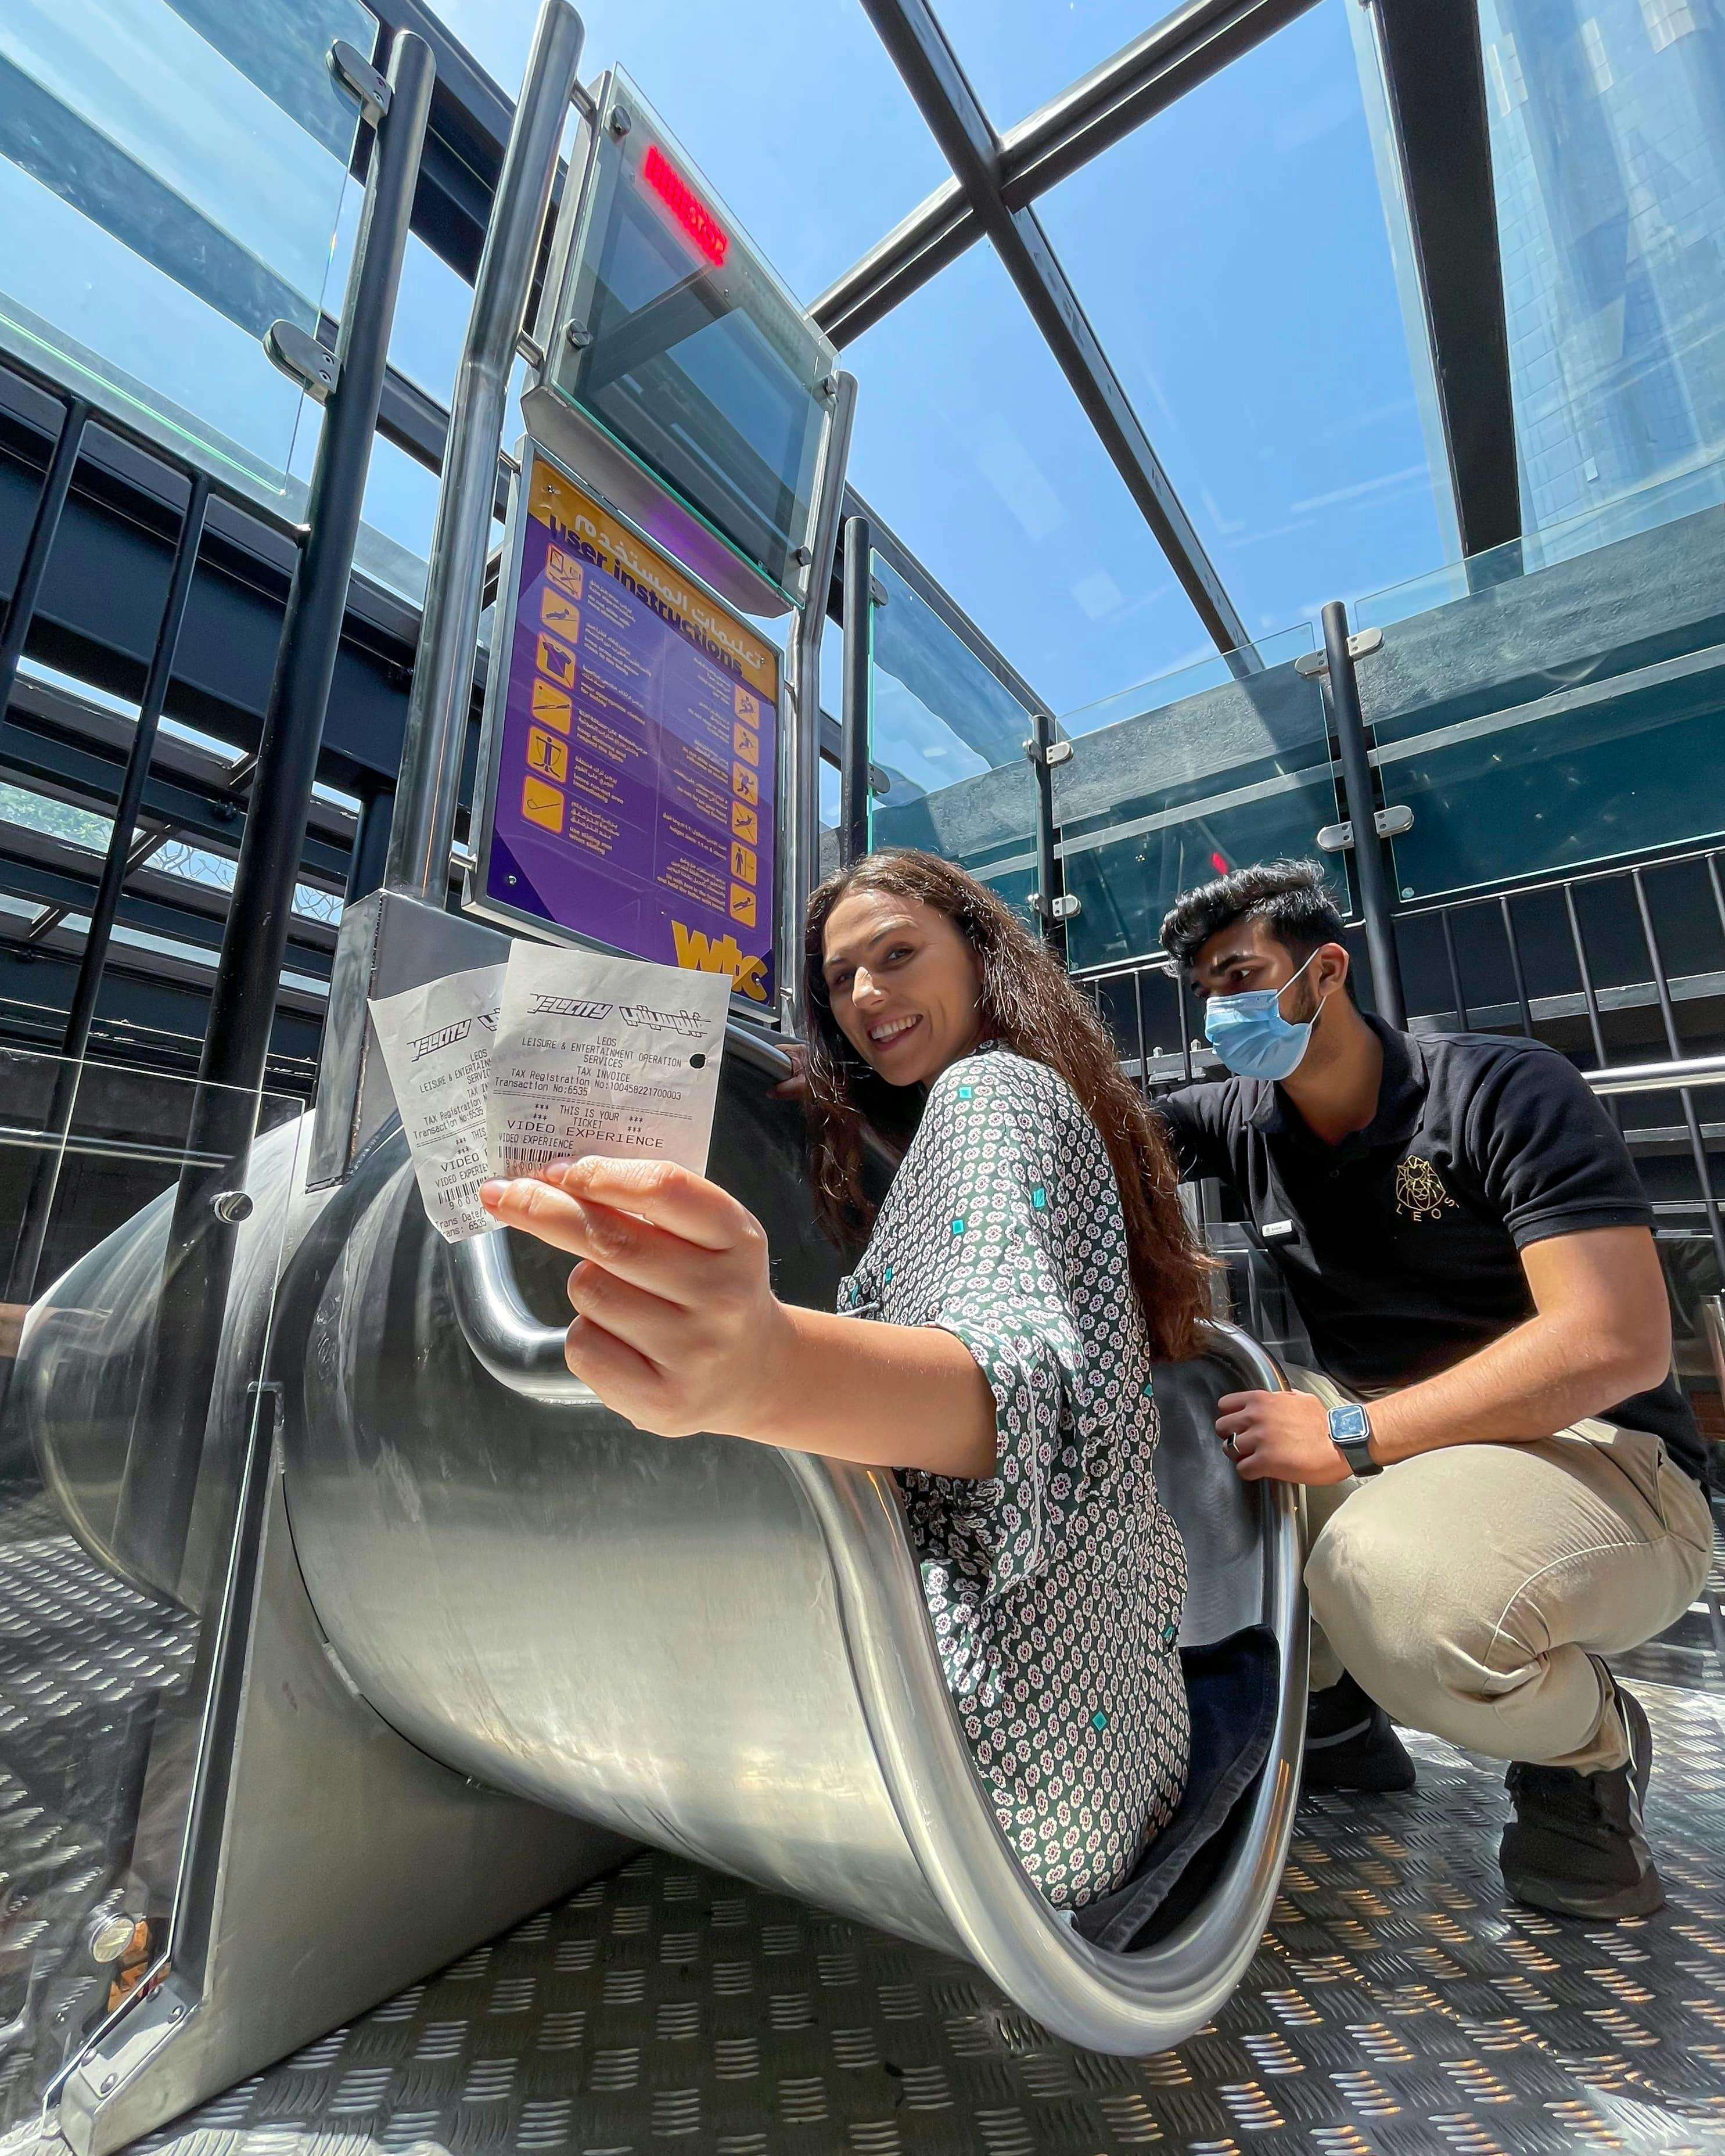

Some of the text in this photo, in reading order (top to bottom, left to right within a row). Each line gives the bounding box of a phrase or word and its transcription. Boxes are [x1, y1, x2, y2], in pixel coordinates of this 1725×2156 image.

[576, 513, 688, 610] المستخدم
[549, 514, 608, 569] user
[614, 558, 744, 677] instructions
[691, 608, 762, 670] تعليمات
[527, 993, 613, 1020] VELOCITY
[522, 1036, 682, 1068] LEISURE & ENTERTAINMENT OPERATION
[597, 1036, 617, 1047] LEOS
[470, 1048, 488, 1062] LEOS
[583, 1054, 624, 1069] SERVICES
[419, 1076, 447, 1093] LEISURE
[454, 1058, 492, 1079] ENTERTAIN
[466, 1069, 491, 1084] SERVIC
[495, 1077, 549, 1093] Transaction
[511, 1068, 682, 1101] TAX Registration No:100458221700003
[576, 1066, 631, 1083] TAX INVOICE
[466, 1087, 479, 1098] TAX
[423, 1098, 481, 1127] TAX Registration
[560, 1104, 620, 1121] THIS IS YOUR
[413, 1119, 458, 1140] Transaction
[471, 1127, 487, 1139] THIS
[507, 1119, 664, 1148] VIDEO EXPERIENCE
[573, 1117, 603, 1130] TICKET
[498, 1132, 574, 1150] VIDEO EXPERIENCE
[440, 1152, 480, 1173] VIDEO
[435, 1163, 488, 1188] VIDEO EXPERIE
[435, 1217, 458, 1230] Trans
[462, 1206, 487, 1223] Date/T
[1396, 1196, 1455, 1222] LEOS
[469, 1218, 487, 1231] 6535
